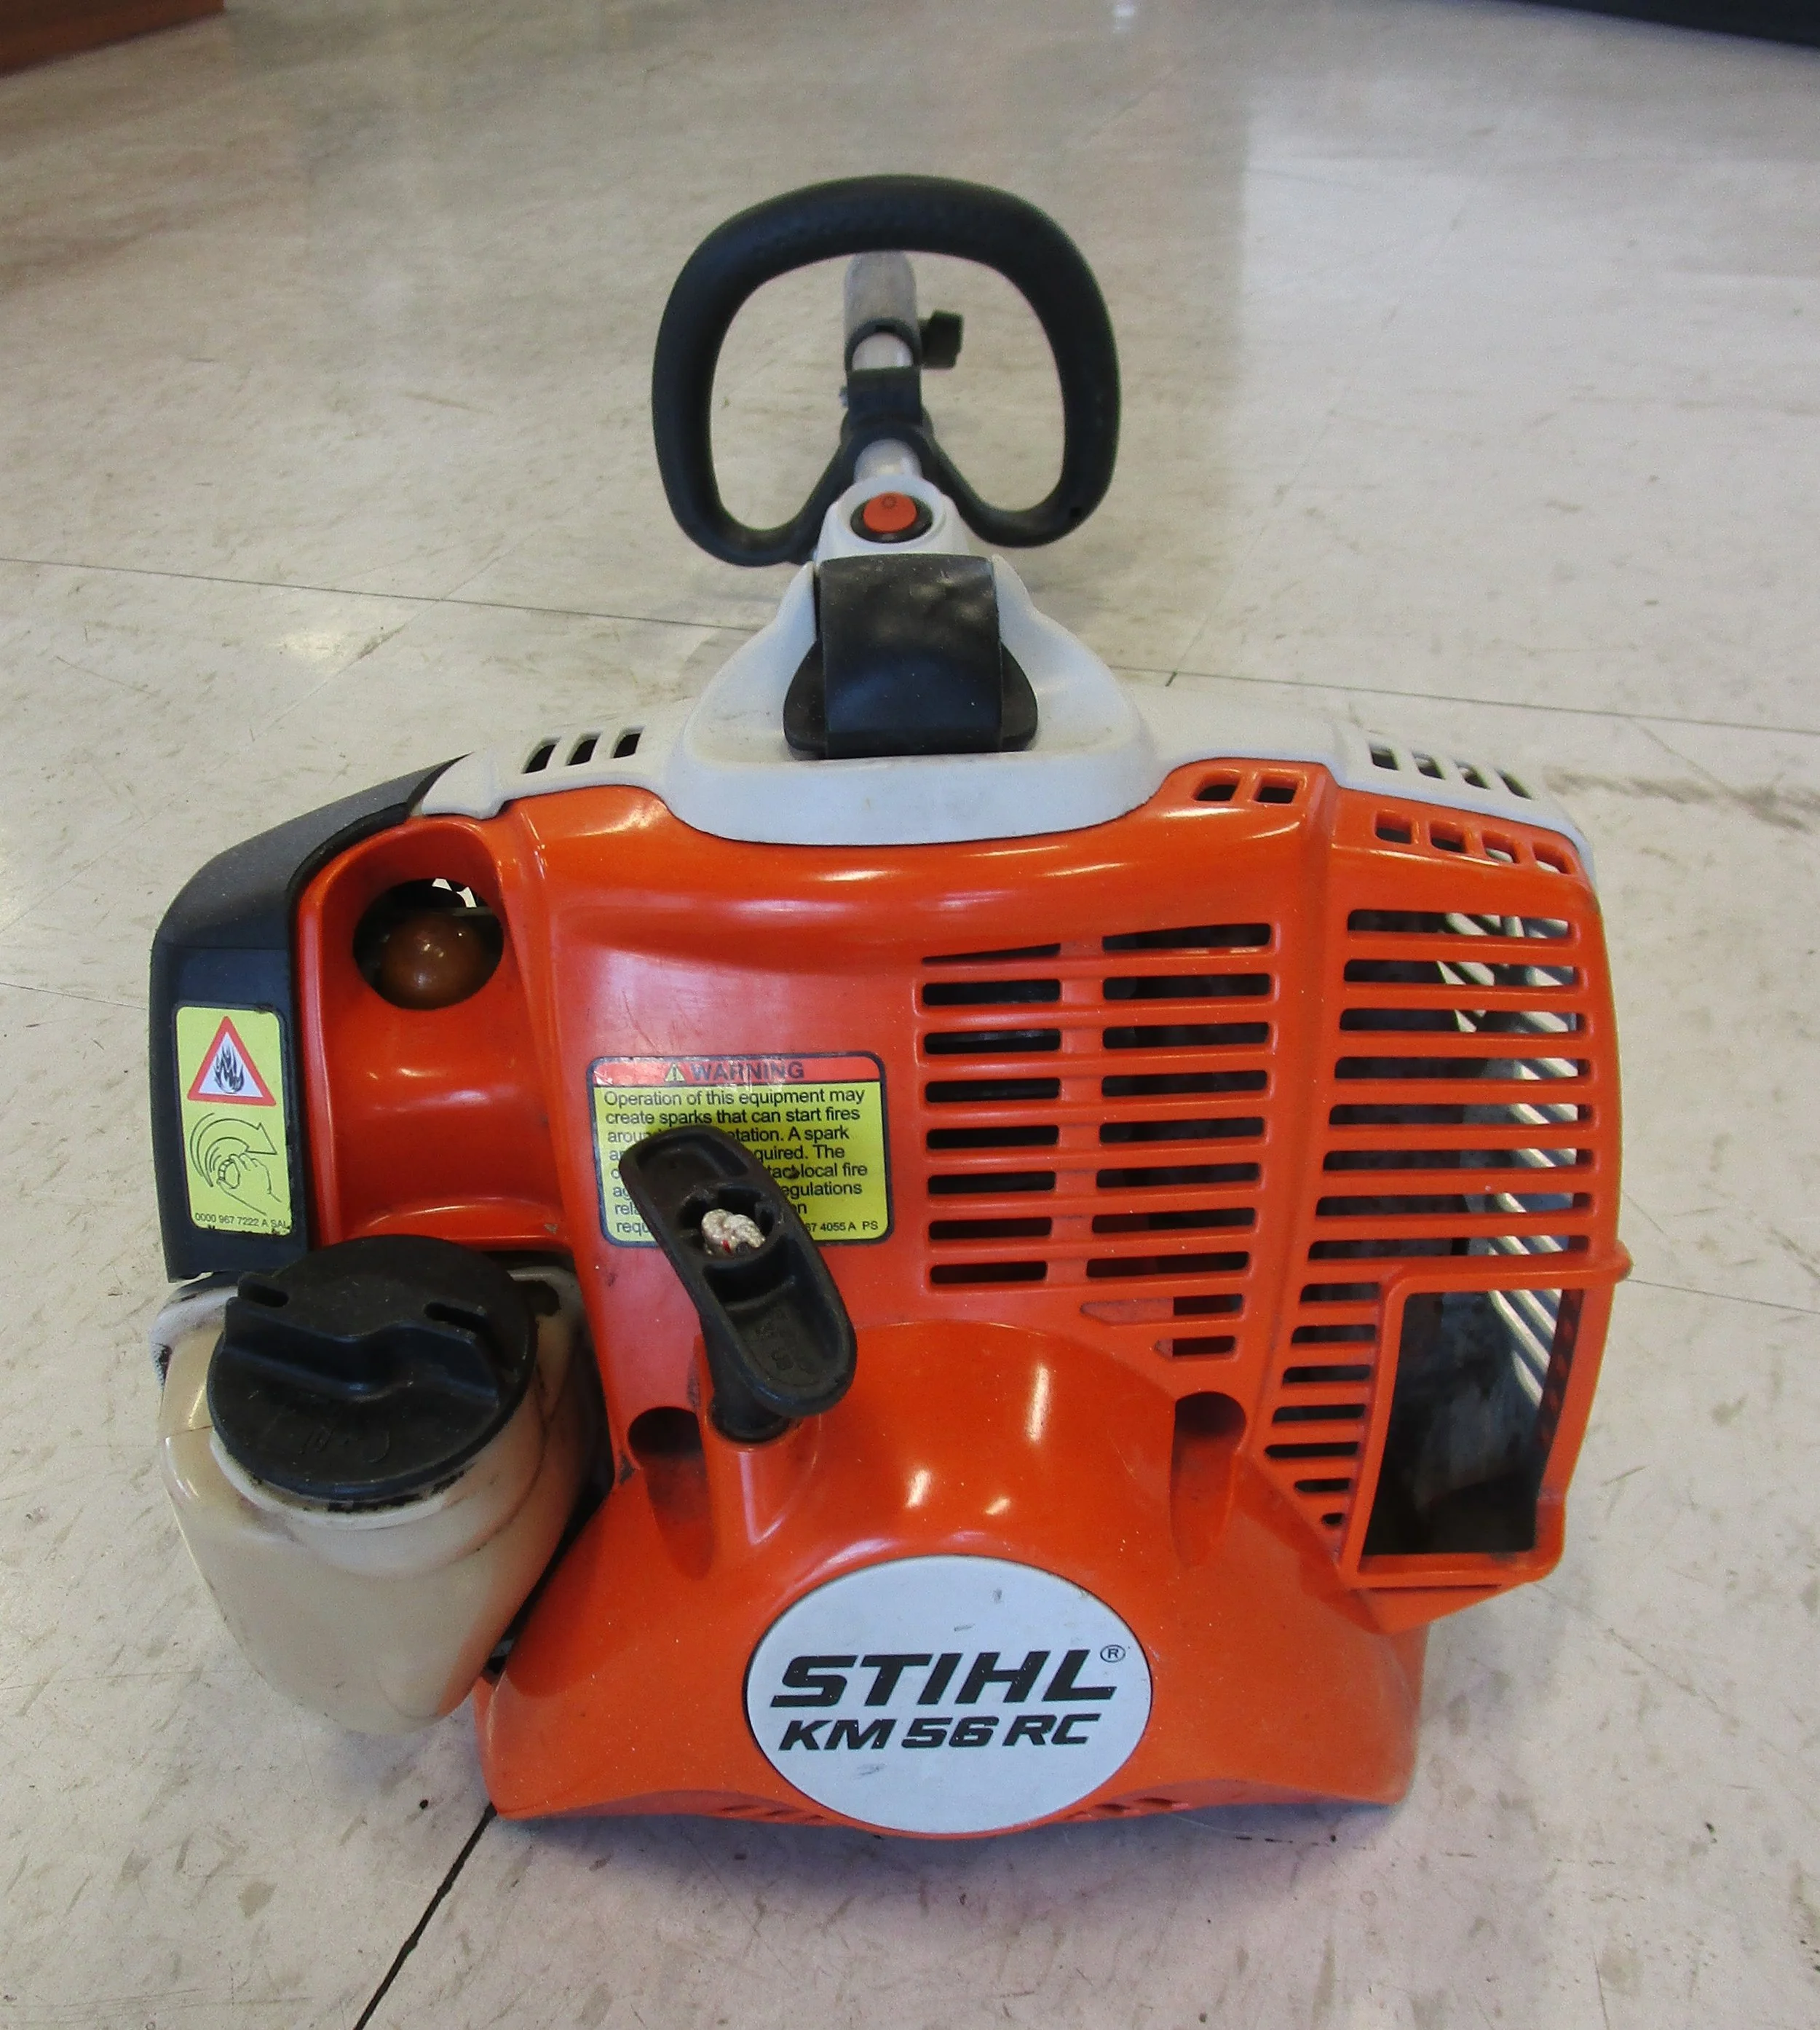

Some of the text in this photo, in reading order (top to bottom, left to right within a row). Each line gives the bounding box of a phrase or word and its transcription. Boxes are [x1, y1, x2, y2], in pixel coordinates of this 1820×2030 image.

[692, 1062, 804, 1081] WARNING
[604, 1089, 865, 1109] Operation of this equipment may
[606, 1106, 860, 1127] create sparks that can start fires
[729, 1127, 783, 1142] tation.
[788, 1126, 800, 1140] A
[804, 1125, 850, 1143] spark
[753, 1145, 844, 1162] quired. The
[802, 1163, 837, 1177] local
[842, 1163, 868, 1177] fire
[780, 1181, 863, 1199] egulations
[194, 1212, 216, 1223] 0000
[218, 1215, 234, 1224] 967
[237, 1216, 259, 1226] 7222
[261, 1218, 269, 1228] A
[820, 1223, 845, 1232] 4055
[847, 1222, 856, 1231] A
[862, 1220, 878, 1231] PS
[770, 1649, 1117, 1707] STIHL
[778, 1713, 1101, 1750] KM 56 RC
